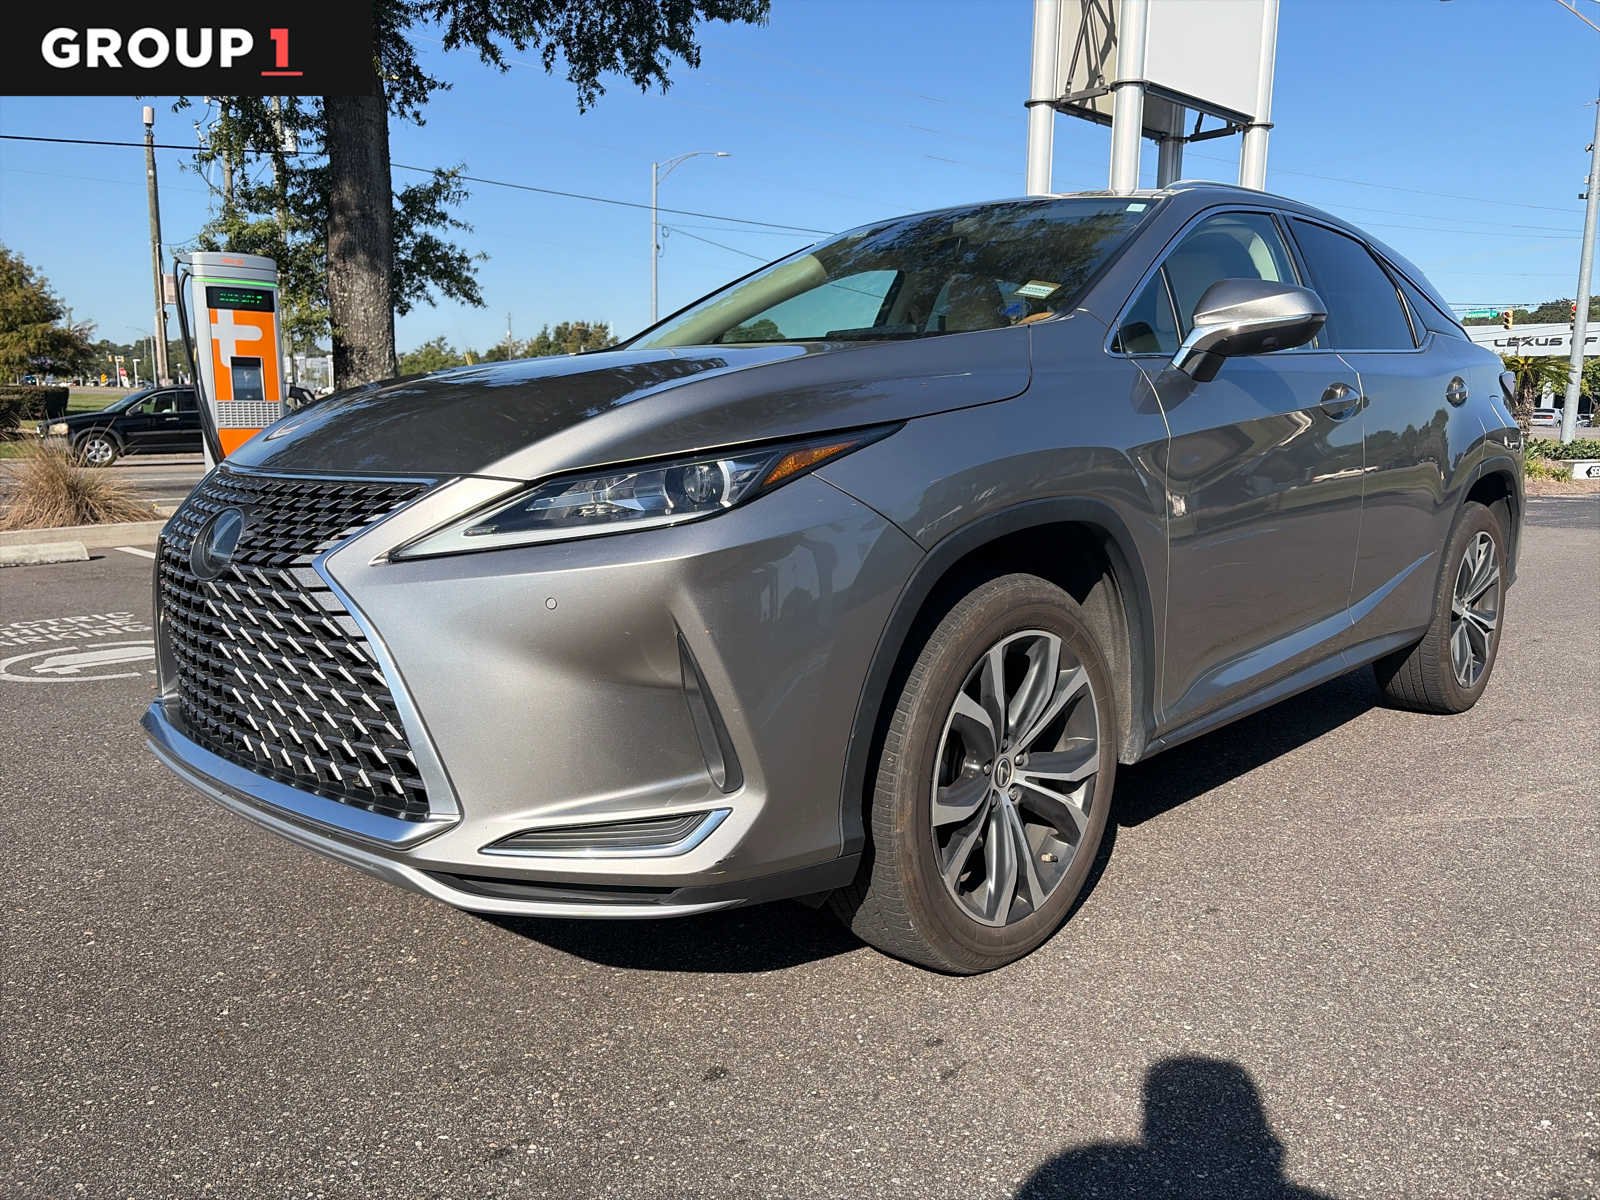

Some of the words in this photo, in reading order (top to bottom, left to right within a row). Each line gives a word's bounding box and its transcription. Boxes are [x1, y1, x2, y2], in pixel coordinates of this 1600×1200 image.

[1494, 336, 1562, 347] LEXUS
[1569, 336, 1598, 346] F
[0, 611, 135, 630] CTRIC
[0, 618, 143, 638] HICLE
